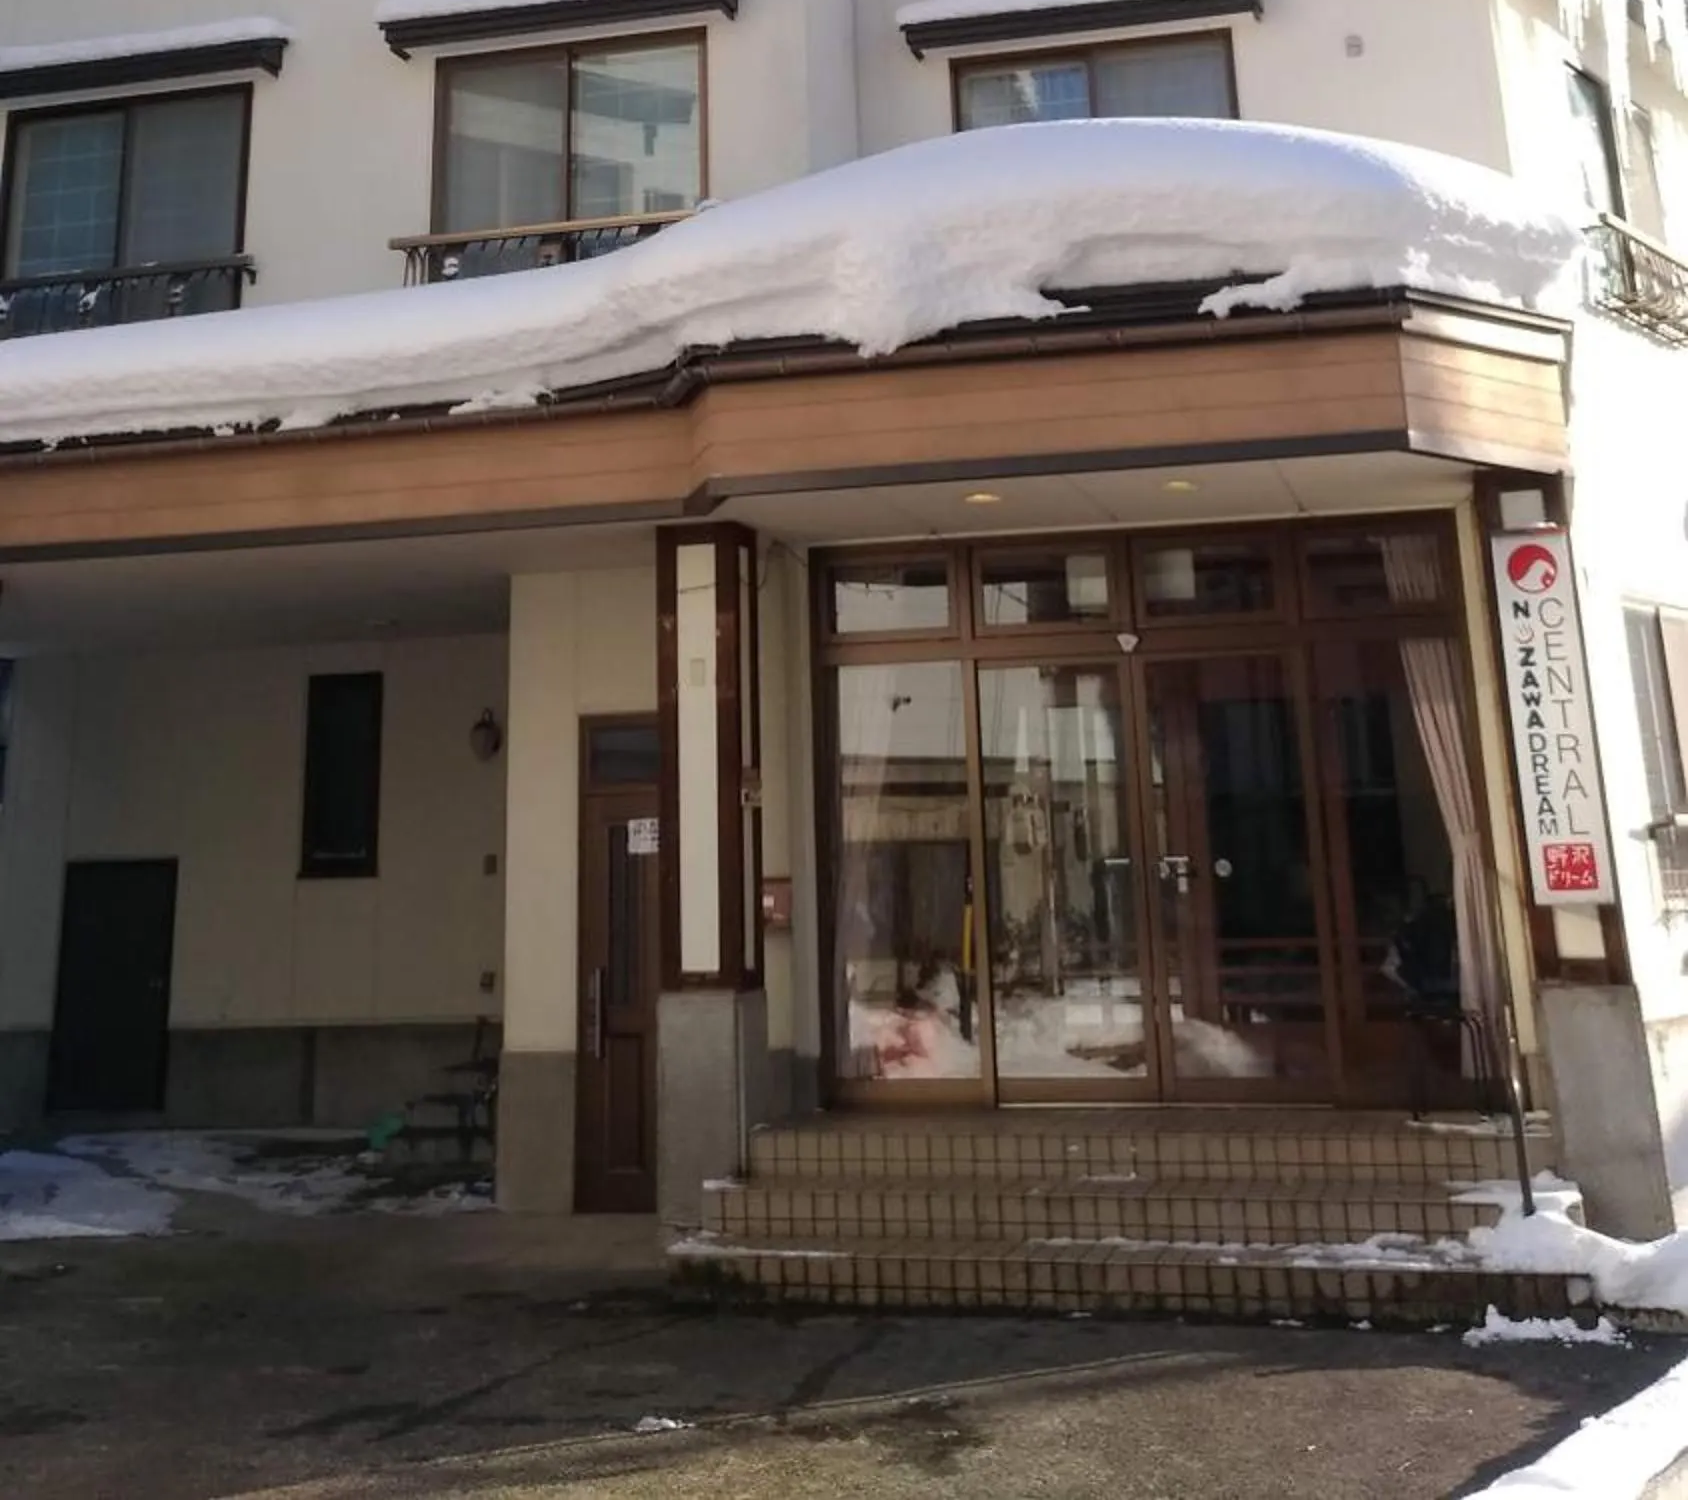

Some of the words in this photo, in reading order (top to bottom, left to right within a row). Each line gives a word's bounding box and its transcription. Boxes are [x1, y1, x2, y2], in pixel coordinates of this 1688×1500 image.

[1538, 598, 1590, 835] CENTRAL
[1549, 870, 1594, 887] ドリーム
